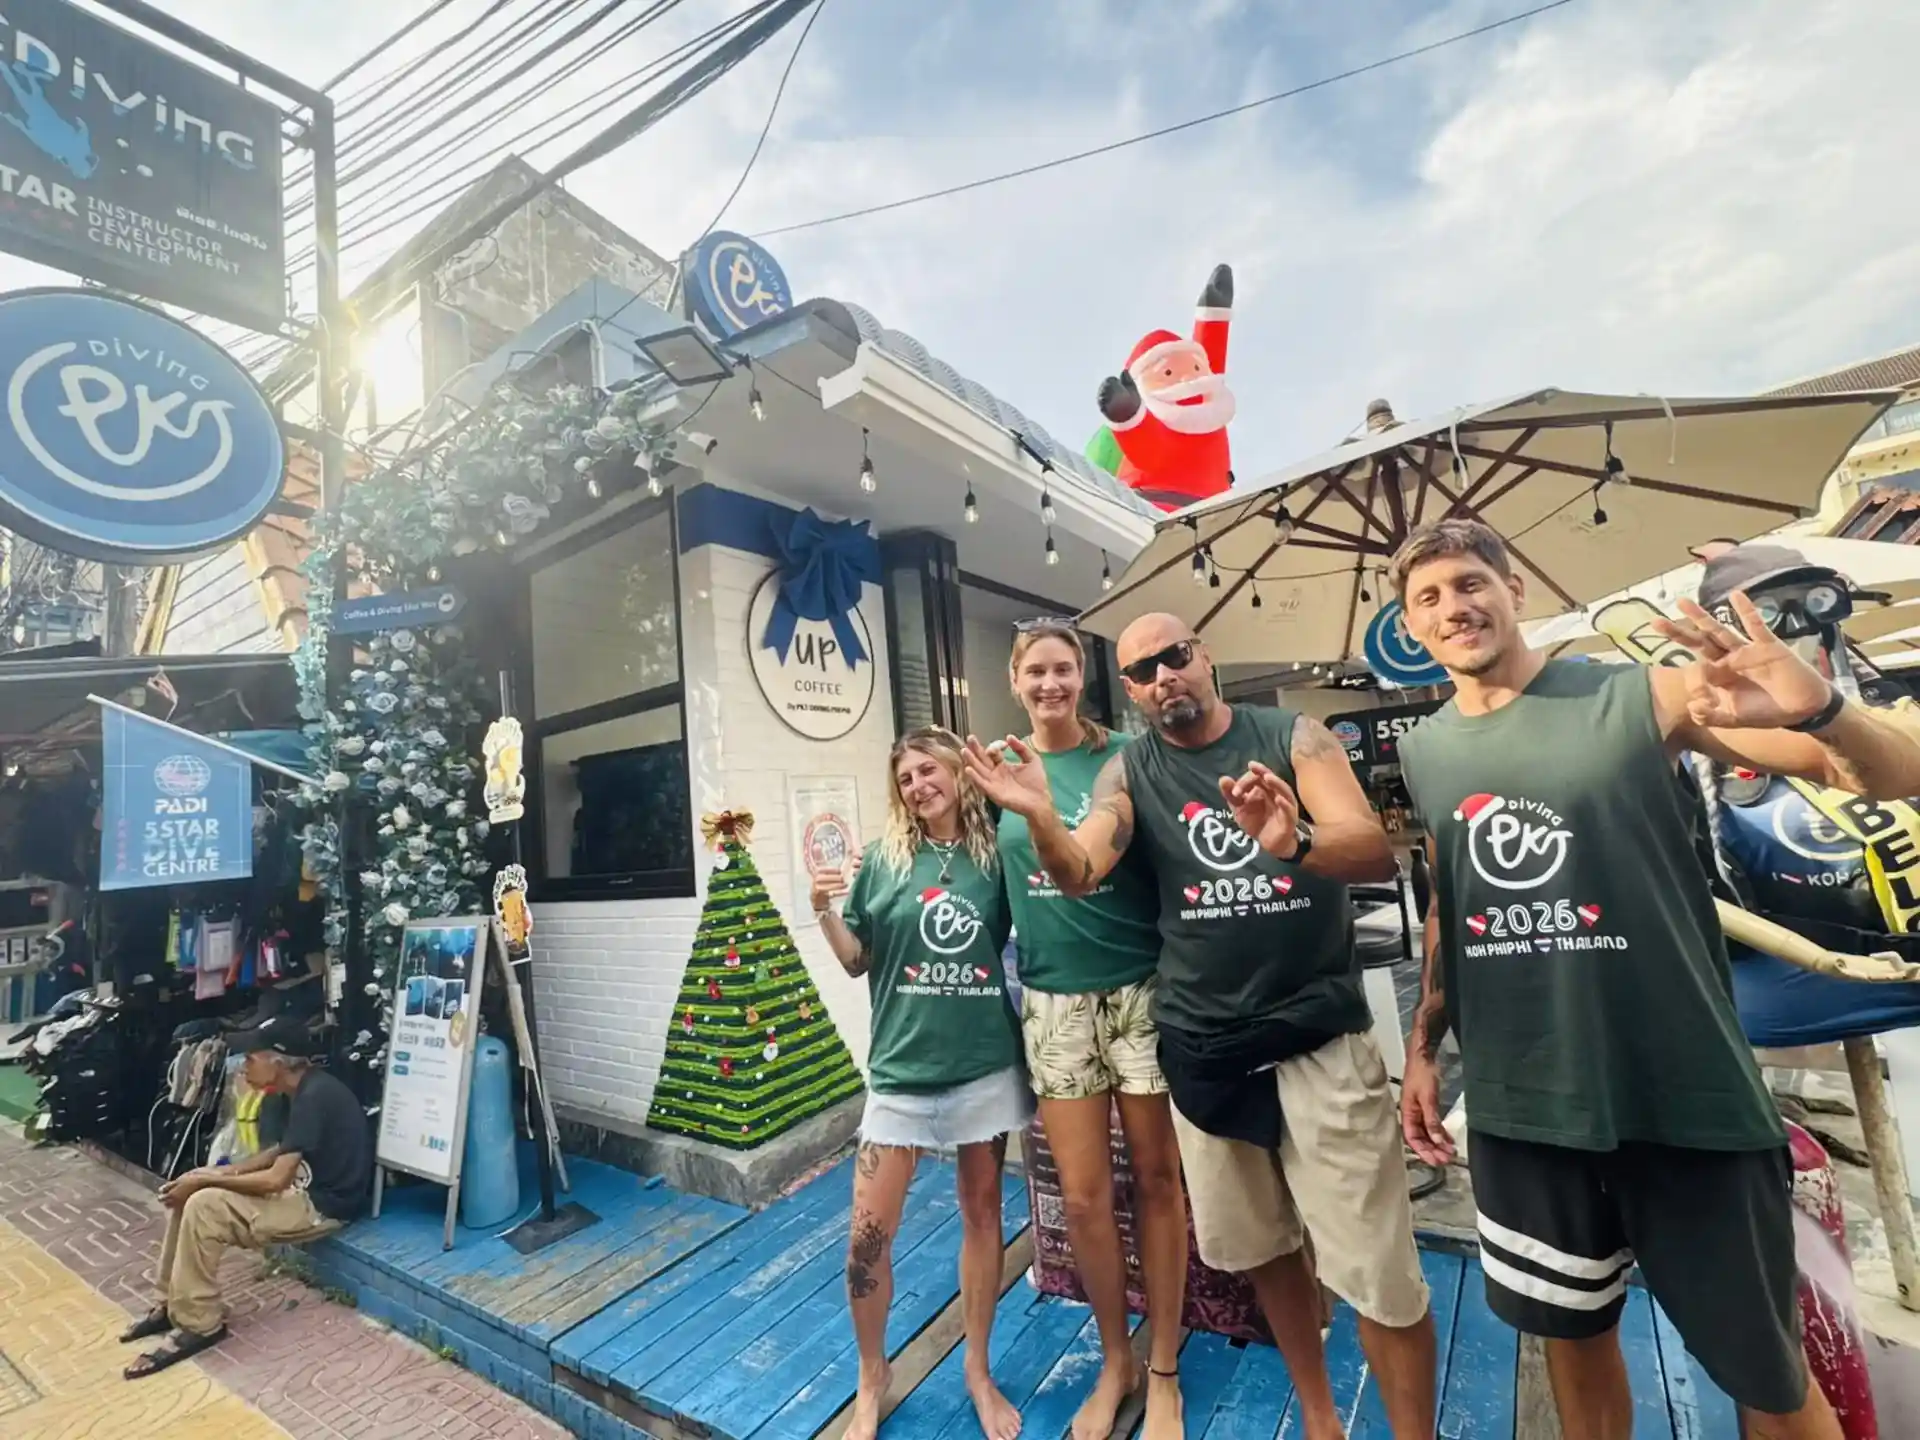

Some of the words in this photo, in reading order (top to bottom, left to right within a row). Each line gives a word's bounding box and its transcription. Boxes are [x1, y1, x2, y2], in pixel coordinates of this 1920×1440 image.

[87, 195, 223, 256] INSTRUCTOR
[88, 212, 241, 275] DEVELOPMENT
[88, 229, 171, 266] CENTER
[795, 680, 843, 695] COFFEE
[155, 798, 208, 814] PADI
[143, 838, 220, 863] DIVE
[143, 857, 220, 878] CENTRE
[1200, 874, 1272, 905] 2026
[1486, 899, 1577, 937] 2026
[1465, 943, 1486, 958] KOH
[918, 961, 974, 985] 2026
